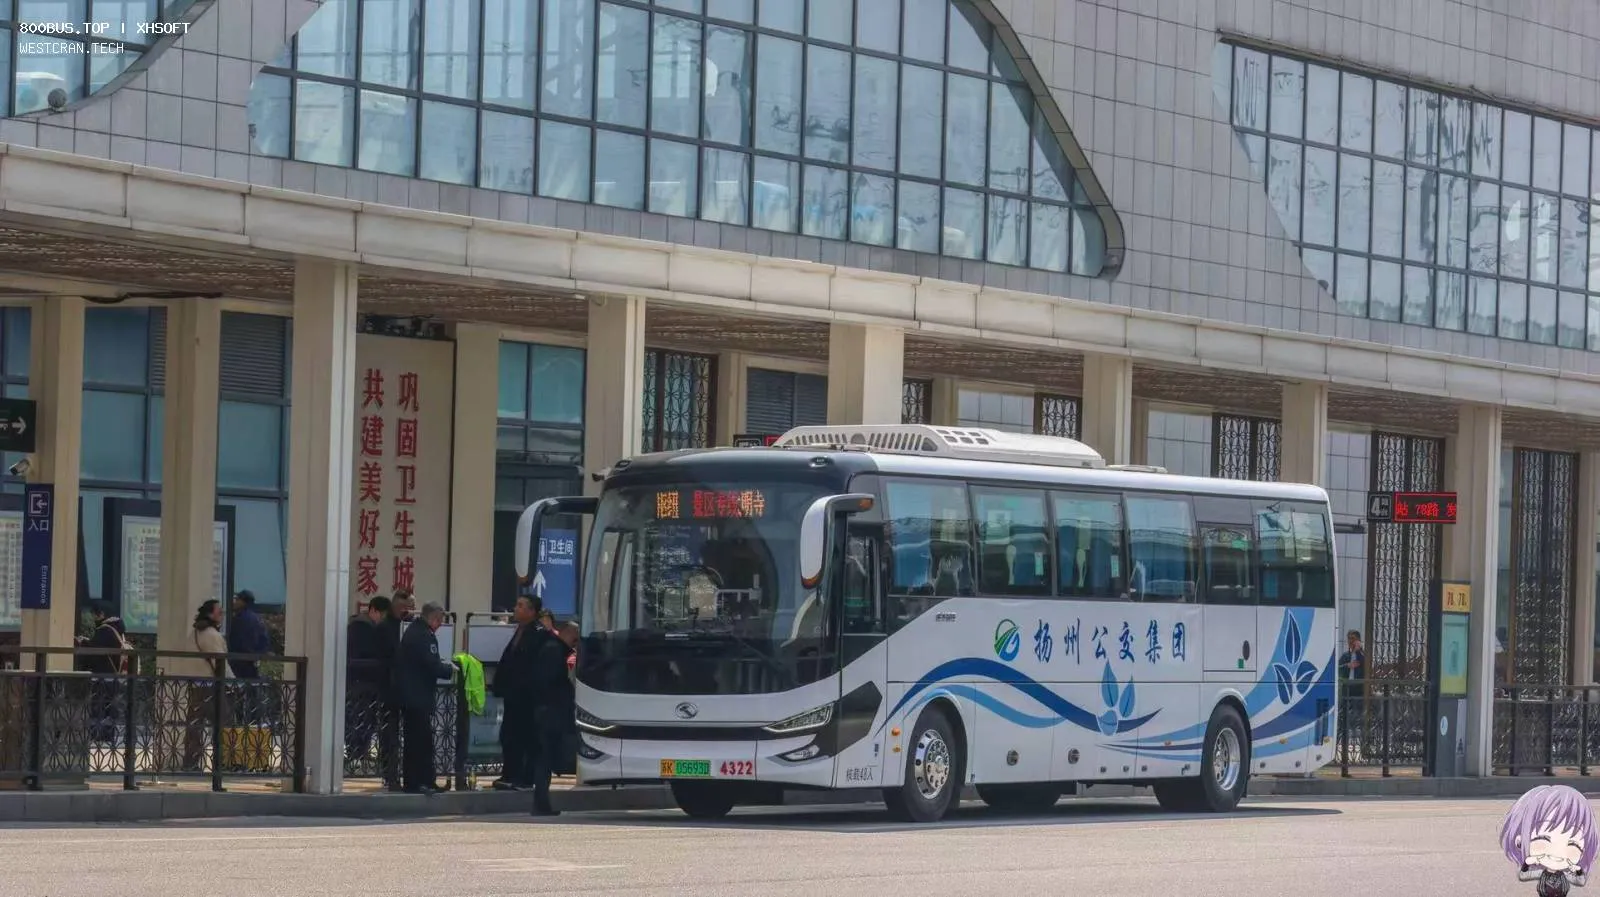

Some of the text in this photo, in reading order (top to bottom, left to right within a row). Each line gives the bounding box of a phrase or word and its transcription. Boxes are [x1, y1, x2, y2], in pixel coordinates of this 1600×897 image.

[392, 371, 419, 611] 巩固卫生城
[28, 518, 49, 531] 入口
[548, 539, 573, 554] 卫生间
[1032, 618, 1187, 666] 扬州公交集团
[720, 761, 753, 775] 4322
